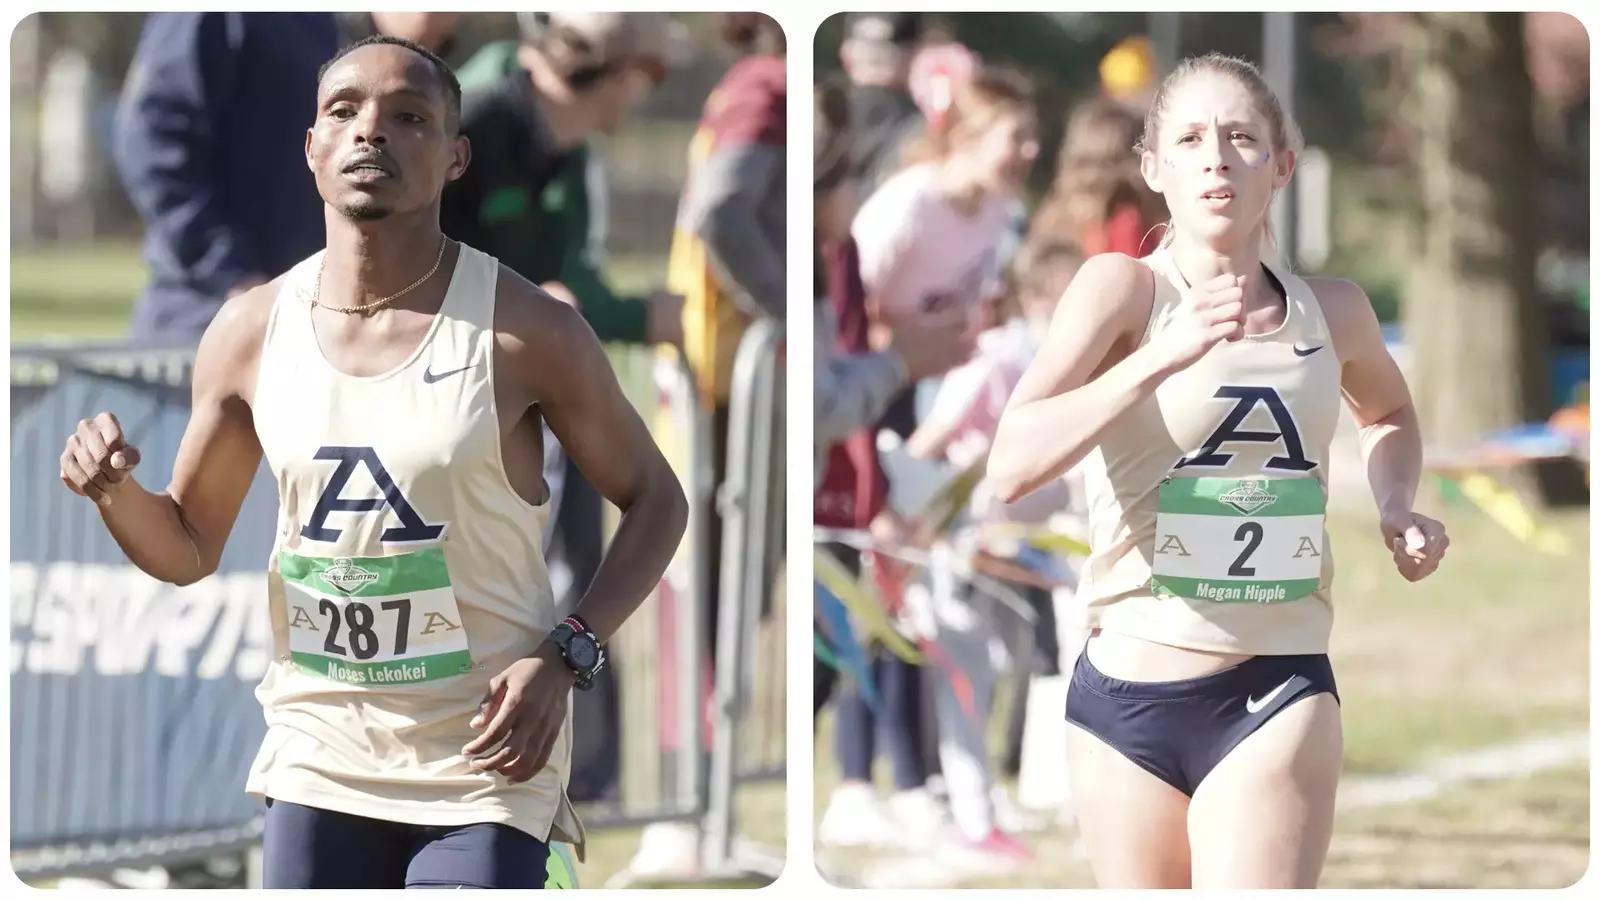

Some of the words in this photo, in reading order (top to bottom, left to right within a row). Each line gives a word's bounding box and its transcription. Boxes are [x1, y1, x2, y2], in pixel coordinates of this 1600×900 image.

[1173, 385, 1319, 472] A
[299, 446, 446, 543] A
[1155, 534, 1191, 557] A
[1227, 521, 1264, 577] 2
[1292, 536, 1321, 558] A
[342, 573, 378, 581] COUNTRY
[1196, 583, 1241, 602] Megan
[1244, 582, 1286, 603] Hipple
[290, 605, 320, 632] A
[318, 598, 412, 661] 287
[420, 611, 461, 635] A
[327, 662, 366, 683] Moses
[368, 661, 427, 683] Lekokei
